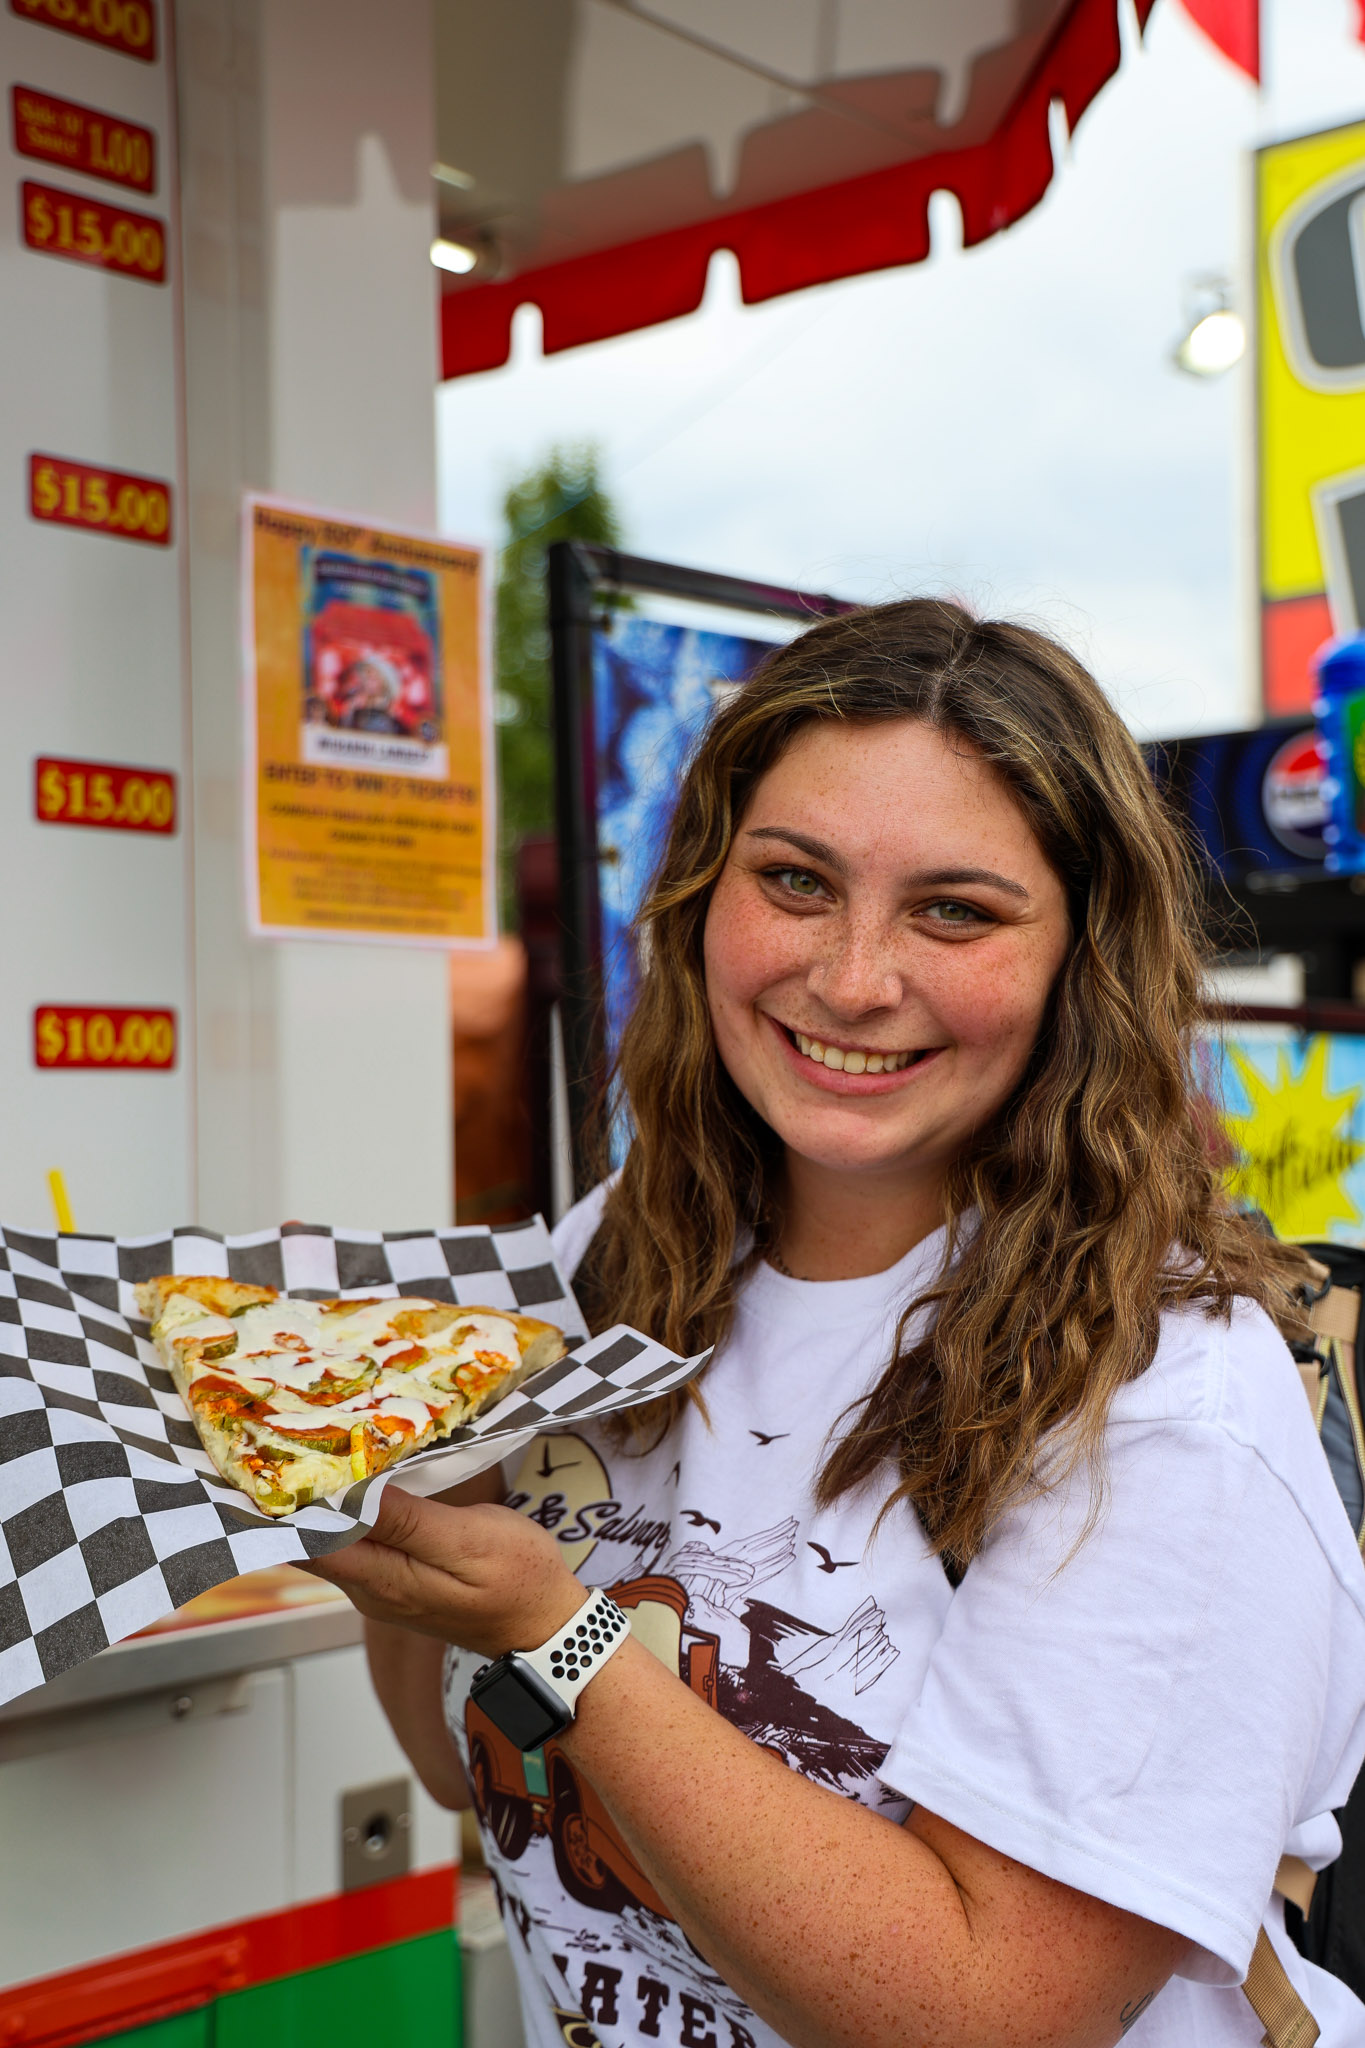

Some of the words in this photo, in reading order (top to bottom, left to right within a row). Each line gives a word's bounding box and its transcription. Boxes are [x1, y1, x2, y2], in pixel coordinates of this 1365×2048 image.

[28, 194, 163, 271] $15.00
[34, 463, 168, 536] $15.00
[38, 763, 173, 827] $15.00
[324, 770, 350, 791] TO
[353, 774, 385, 793] WIN
[38, 1009, 173, 1065] $10.00
[528, 1493, 567, 1529] &
[552, 1953, 758, 2048] ATER
